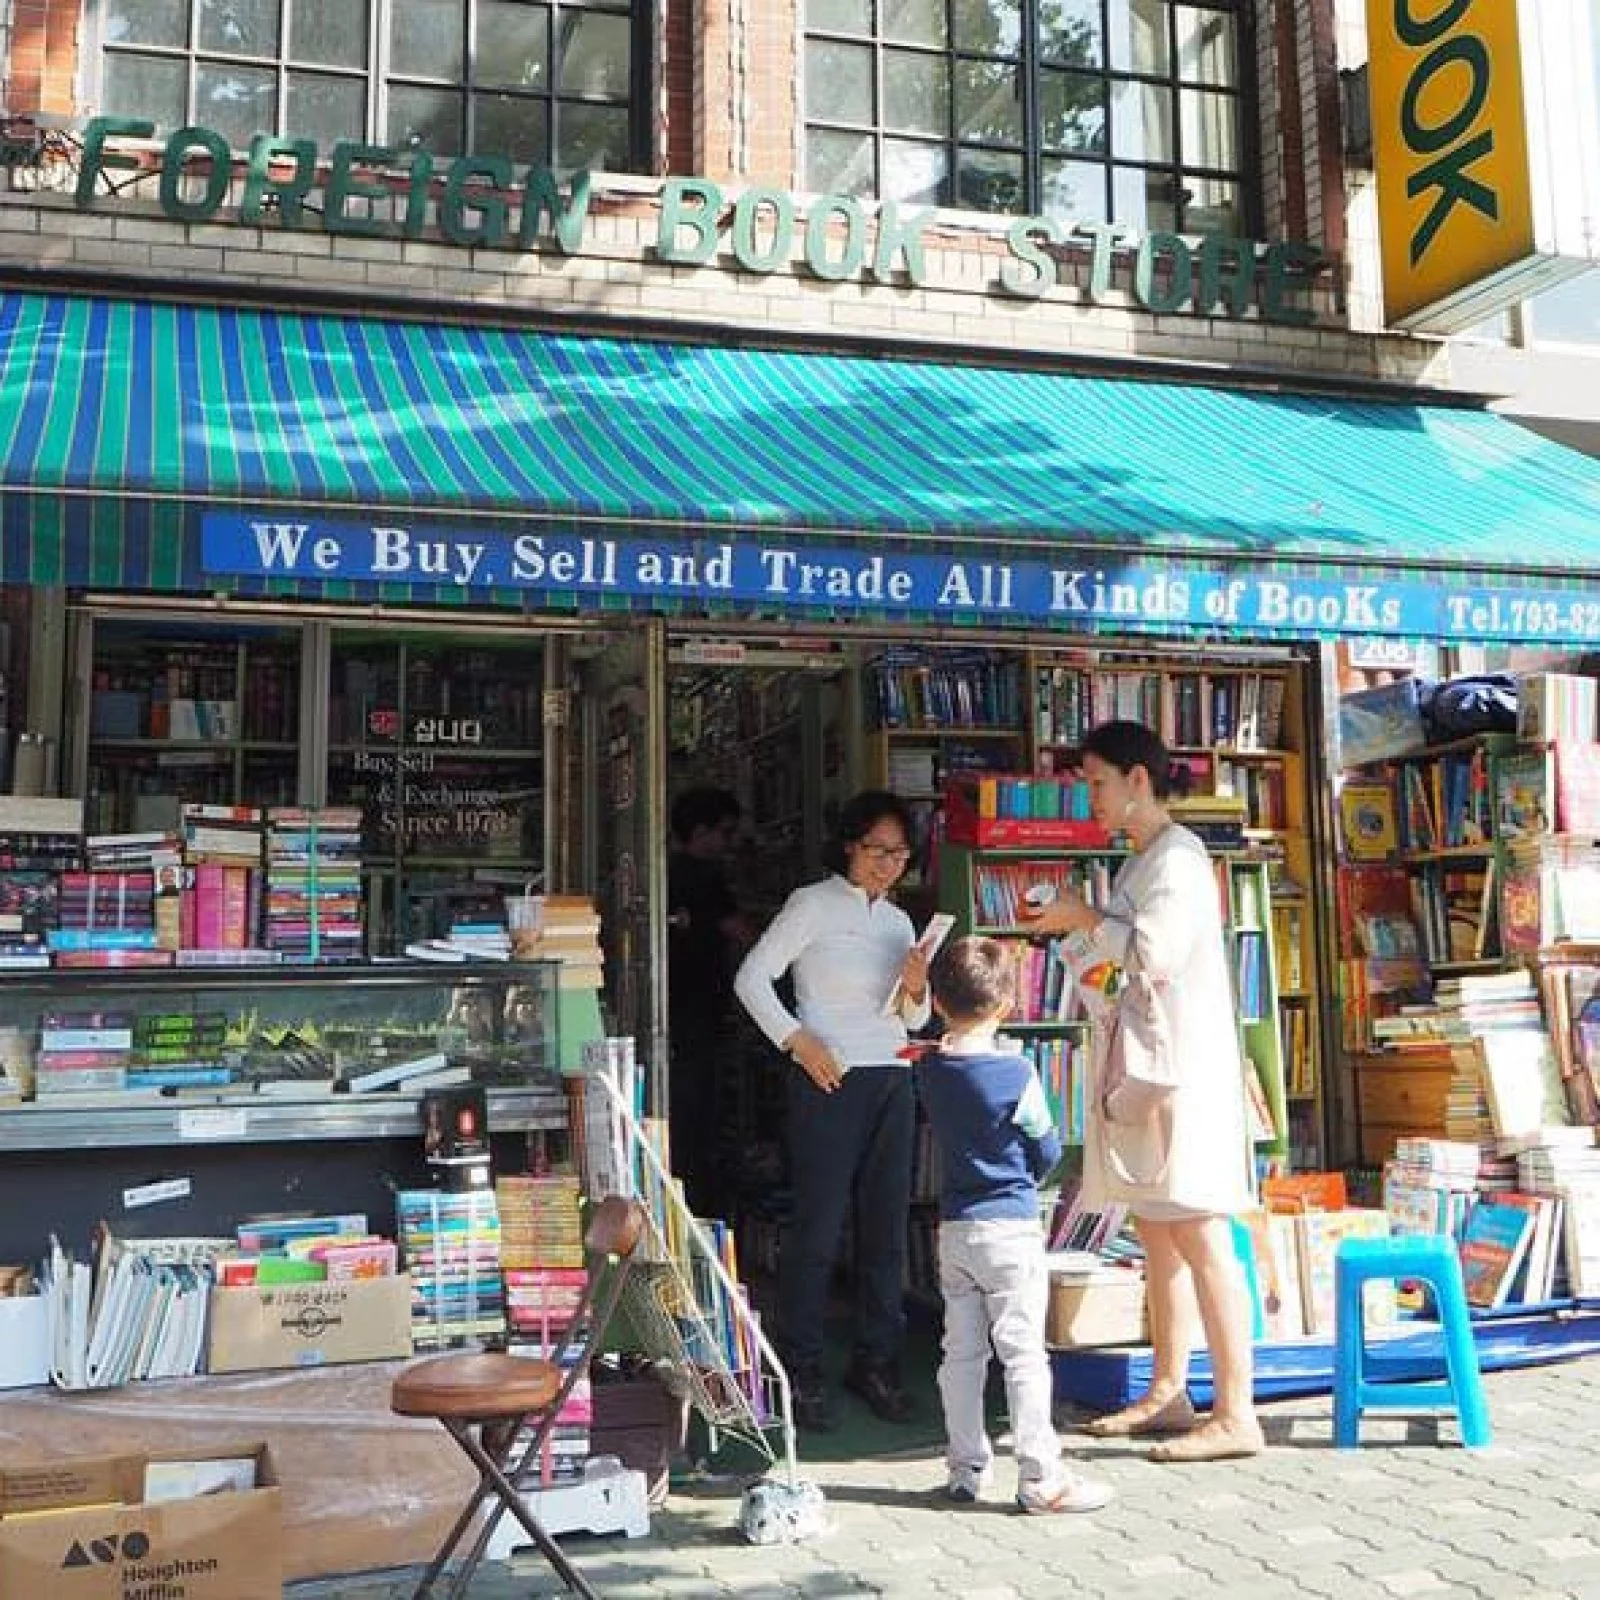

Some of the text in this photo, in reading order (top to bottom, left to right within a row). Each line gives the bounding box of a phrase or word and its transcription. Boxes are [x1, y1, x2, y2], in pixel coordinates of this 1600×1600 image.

[76, 116, 1325, 323] FOREIGN BOOK STORE
[251, 522, 341, 569] We
[370, 527, 493, 585] Buy,
[511, 535, 617, 585] Sell
[638, 545, 734, 588] and
[760, 550, 913, 601] Trade
[936, 563, 1013, 608] All
[1049, 570, 1190, 614] Kinds
[1204, 581, 1246, 624] of
[122, 1558, 218, 1582] Houghton
